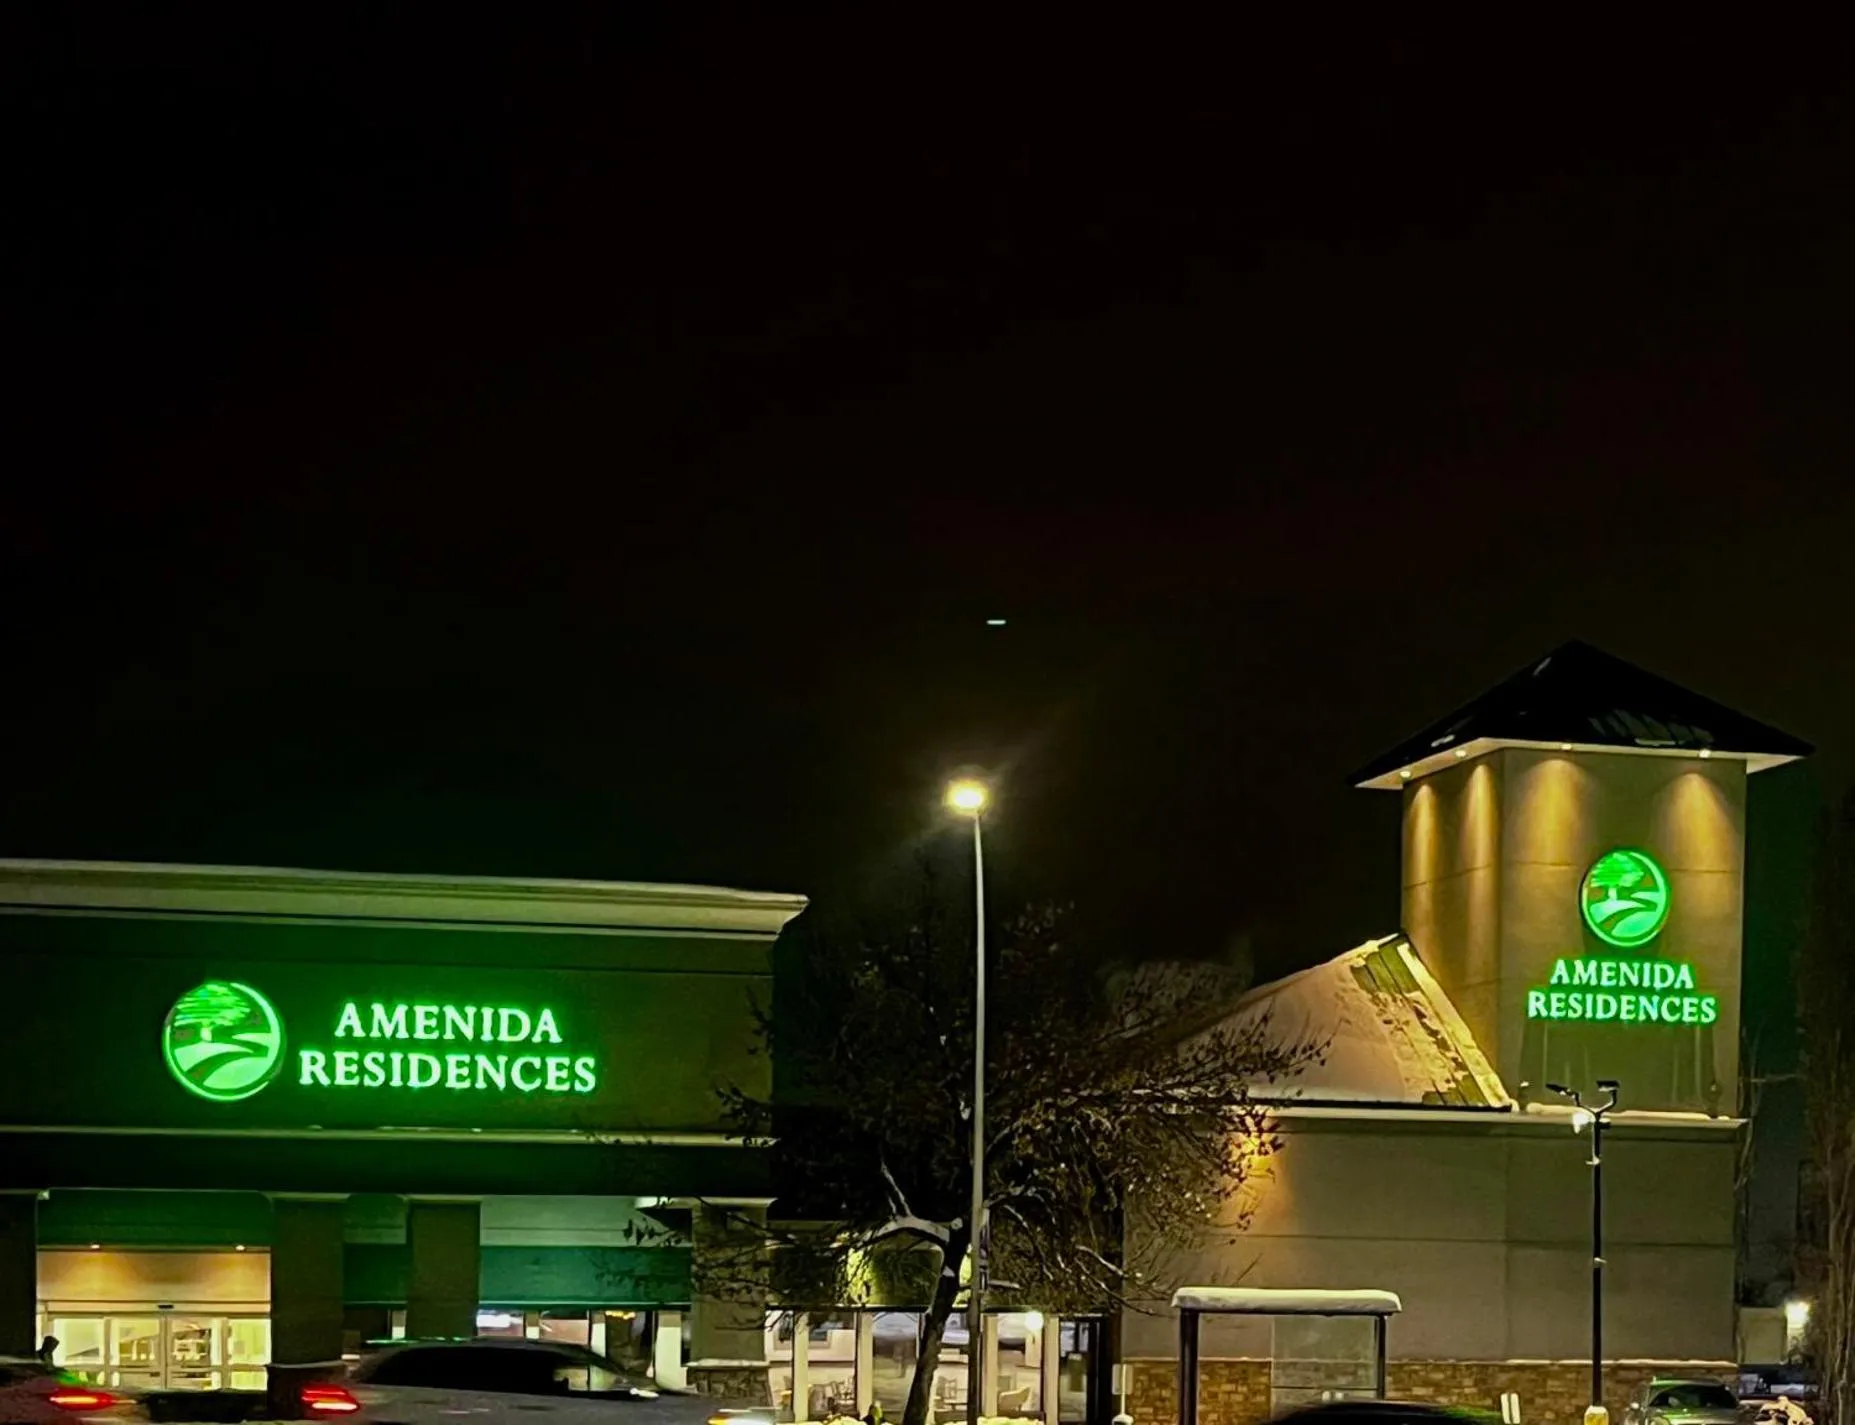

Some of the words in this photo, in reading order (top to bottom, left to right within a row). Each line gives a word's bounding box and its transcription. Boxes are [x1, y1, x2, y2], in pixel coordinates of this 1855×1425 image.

[1550, 959, 1694, 990] AMENIDA
[334, 1002, 562, 1044] AMENIDA
[1528, 990, 1716, 1023] RESIDENCES
[299, 1049, 597, 1092] RESIDENCES
